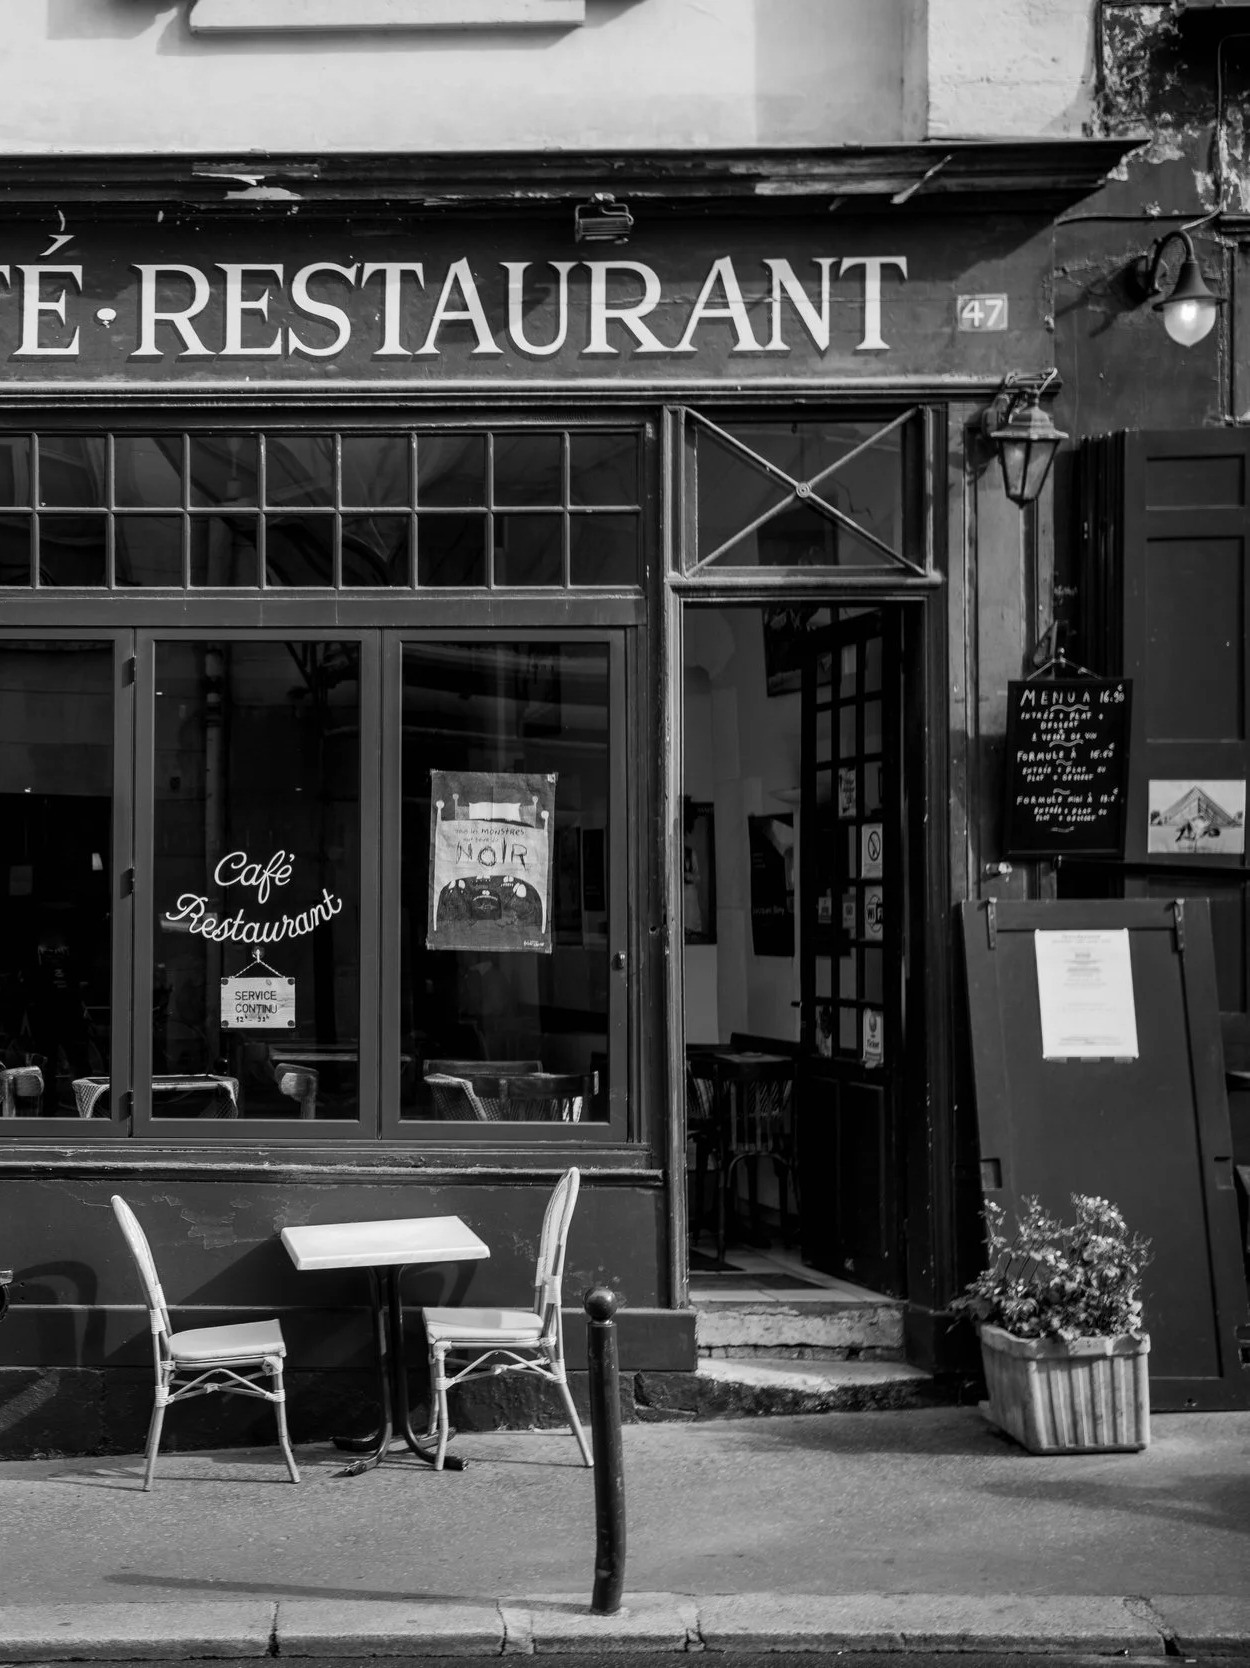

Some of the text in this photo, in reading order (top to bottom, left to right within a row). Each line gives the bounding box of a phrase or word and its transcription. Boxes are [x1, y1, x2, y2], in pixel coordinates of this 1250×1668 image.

[131, 255, 908, 357] RESTAURANT
[960, 300, 1005, 328] 47
[1020, 689, 1076, 707] MENU
[455, 838, 527, 870] NOIR
[214, 850, 295, 904] Café
[165, 888, 342, 943] Restaurant
[234, 990, 277, 1001] SERVICE
[235, 1003, 278, 1014] CONTINU
